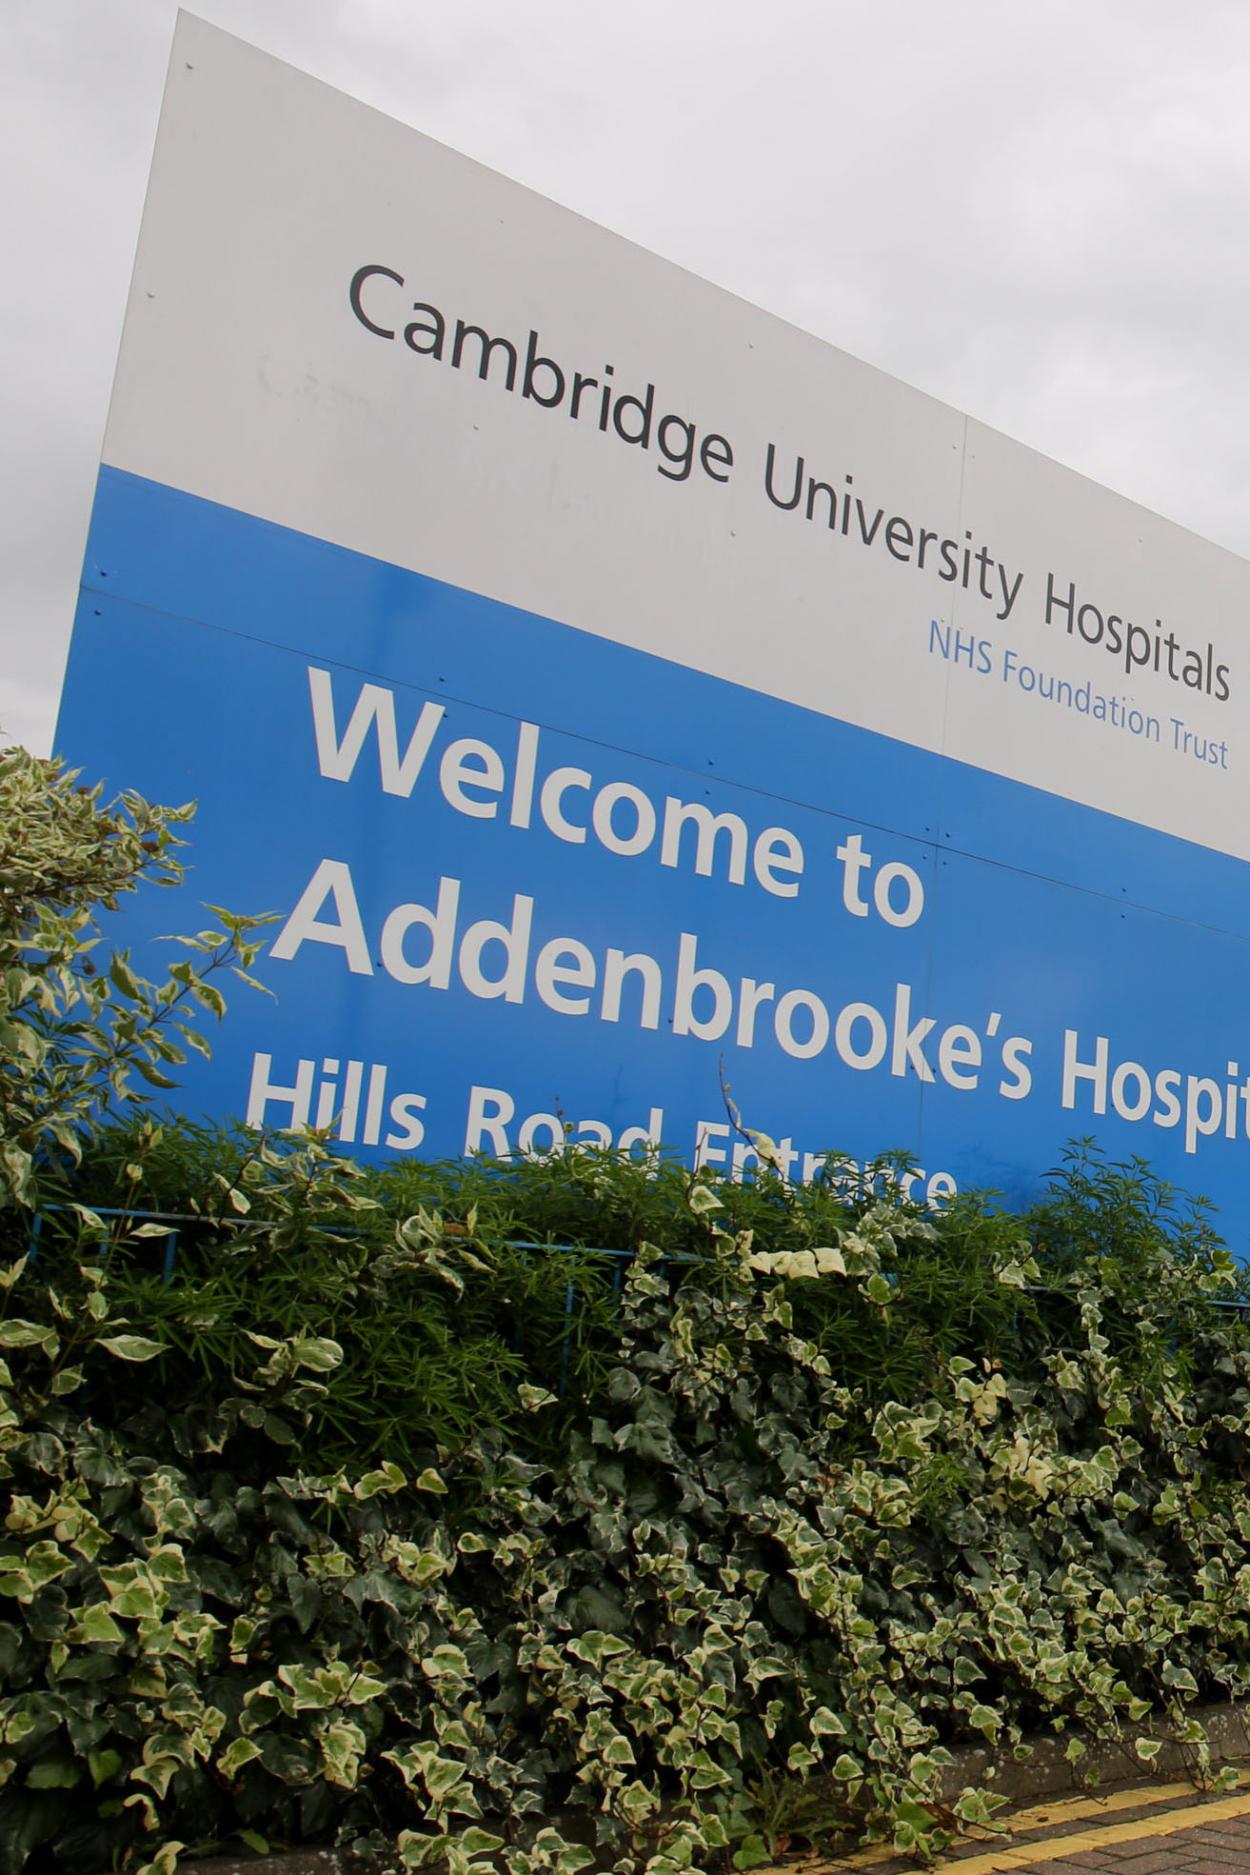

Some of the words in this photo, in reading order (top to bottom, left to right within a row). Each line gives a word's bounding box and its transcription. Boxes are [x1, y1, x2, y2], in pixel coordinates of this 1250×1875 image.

[349, 263, 735, 482] Cambridge
[763, 442, 1023, 620] University
[1045, 573, 1230, 701] Hospitals
[307, 665, 804, 898] Welcome
[836, 834, 925, 928] to
[929, 619, 993, 674] NHS
[1003, 650, 1160, 742] Foundation
[1170, 718, 1229, 770] Trust
[269, 858, 1033, 1100] Addenbrooke's
[246, 1052, 428, 1150] Hills
